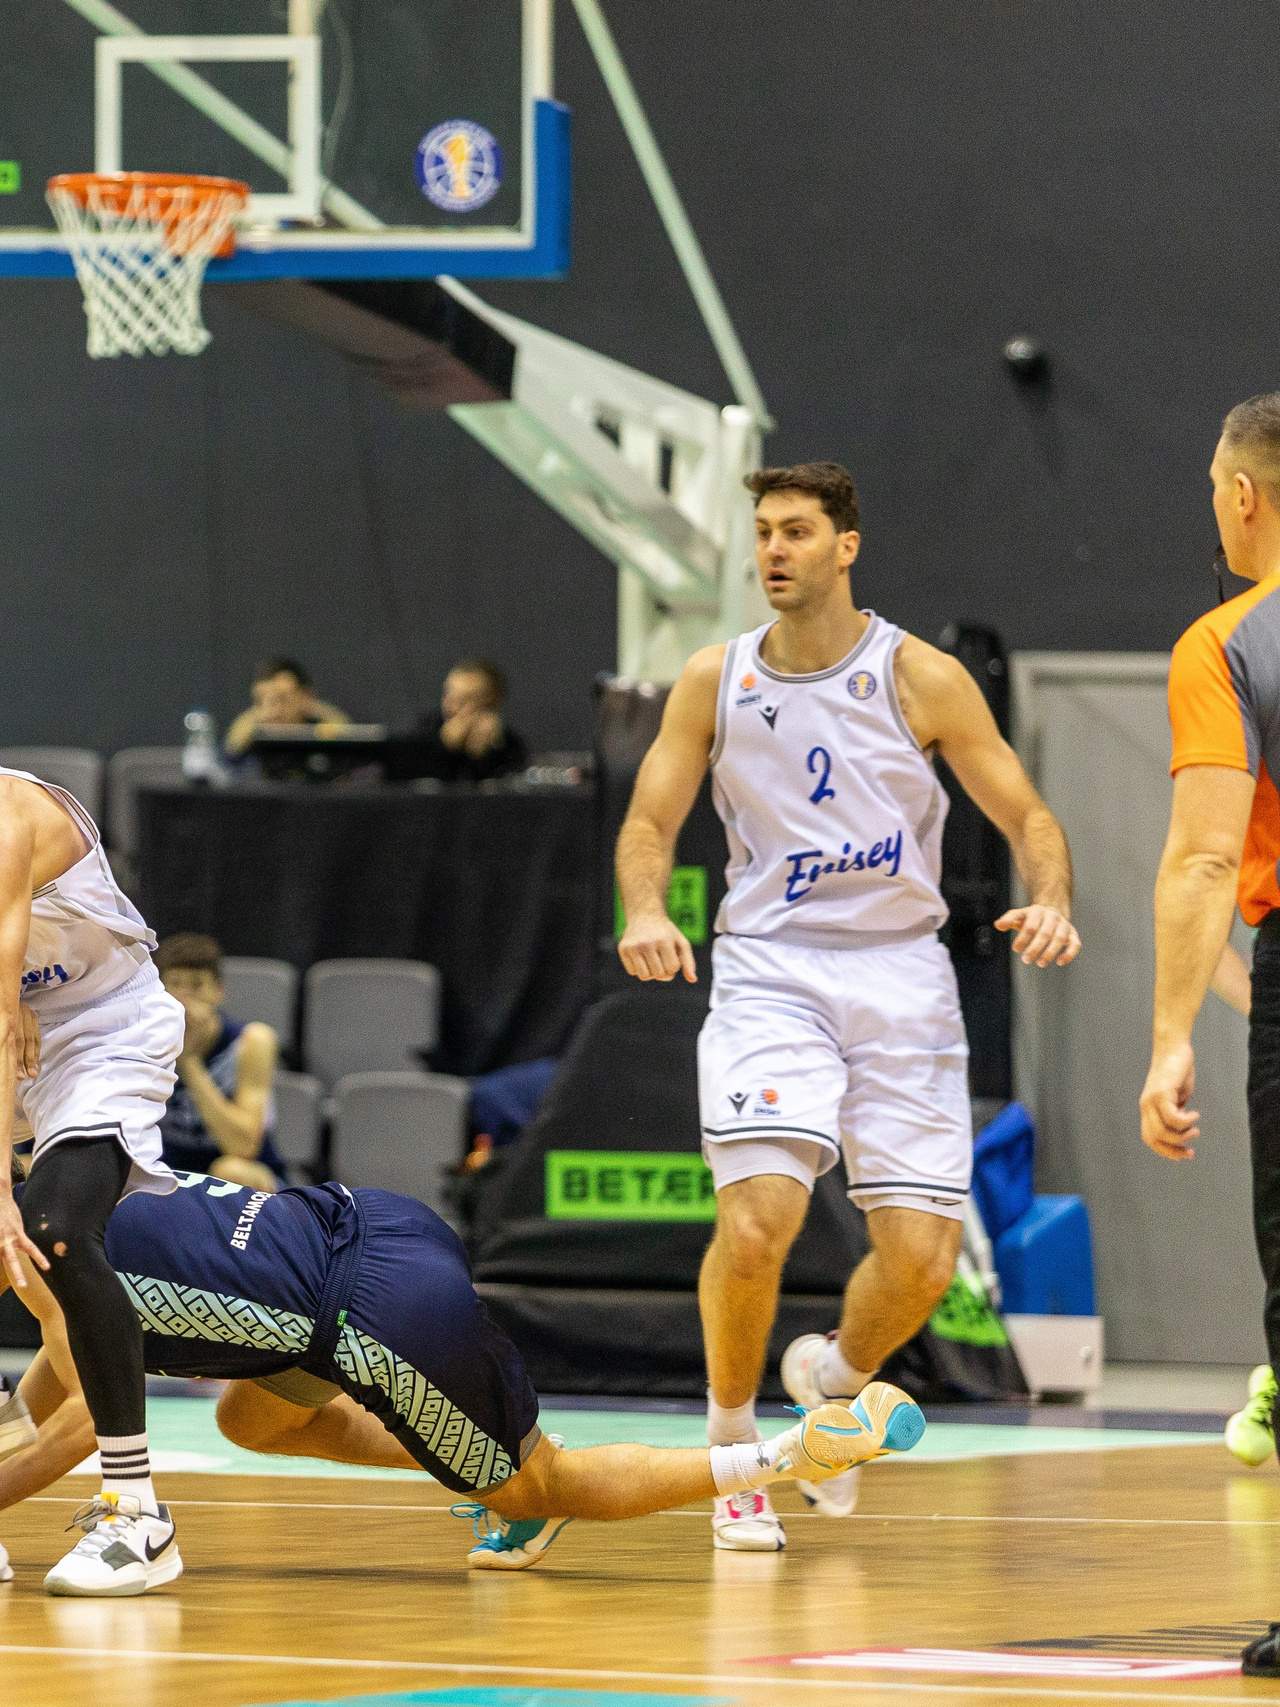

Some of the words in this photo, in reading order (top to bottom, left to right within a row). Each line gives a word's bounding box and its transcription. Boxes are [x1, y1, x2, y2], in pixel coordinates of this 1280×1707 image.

[807, 746, 836, 805] 2
[785, 830, 902, 902] Enisey
[229, 1191, 277, 1251] BELTAMO
